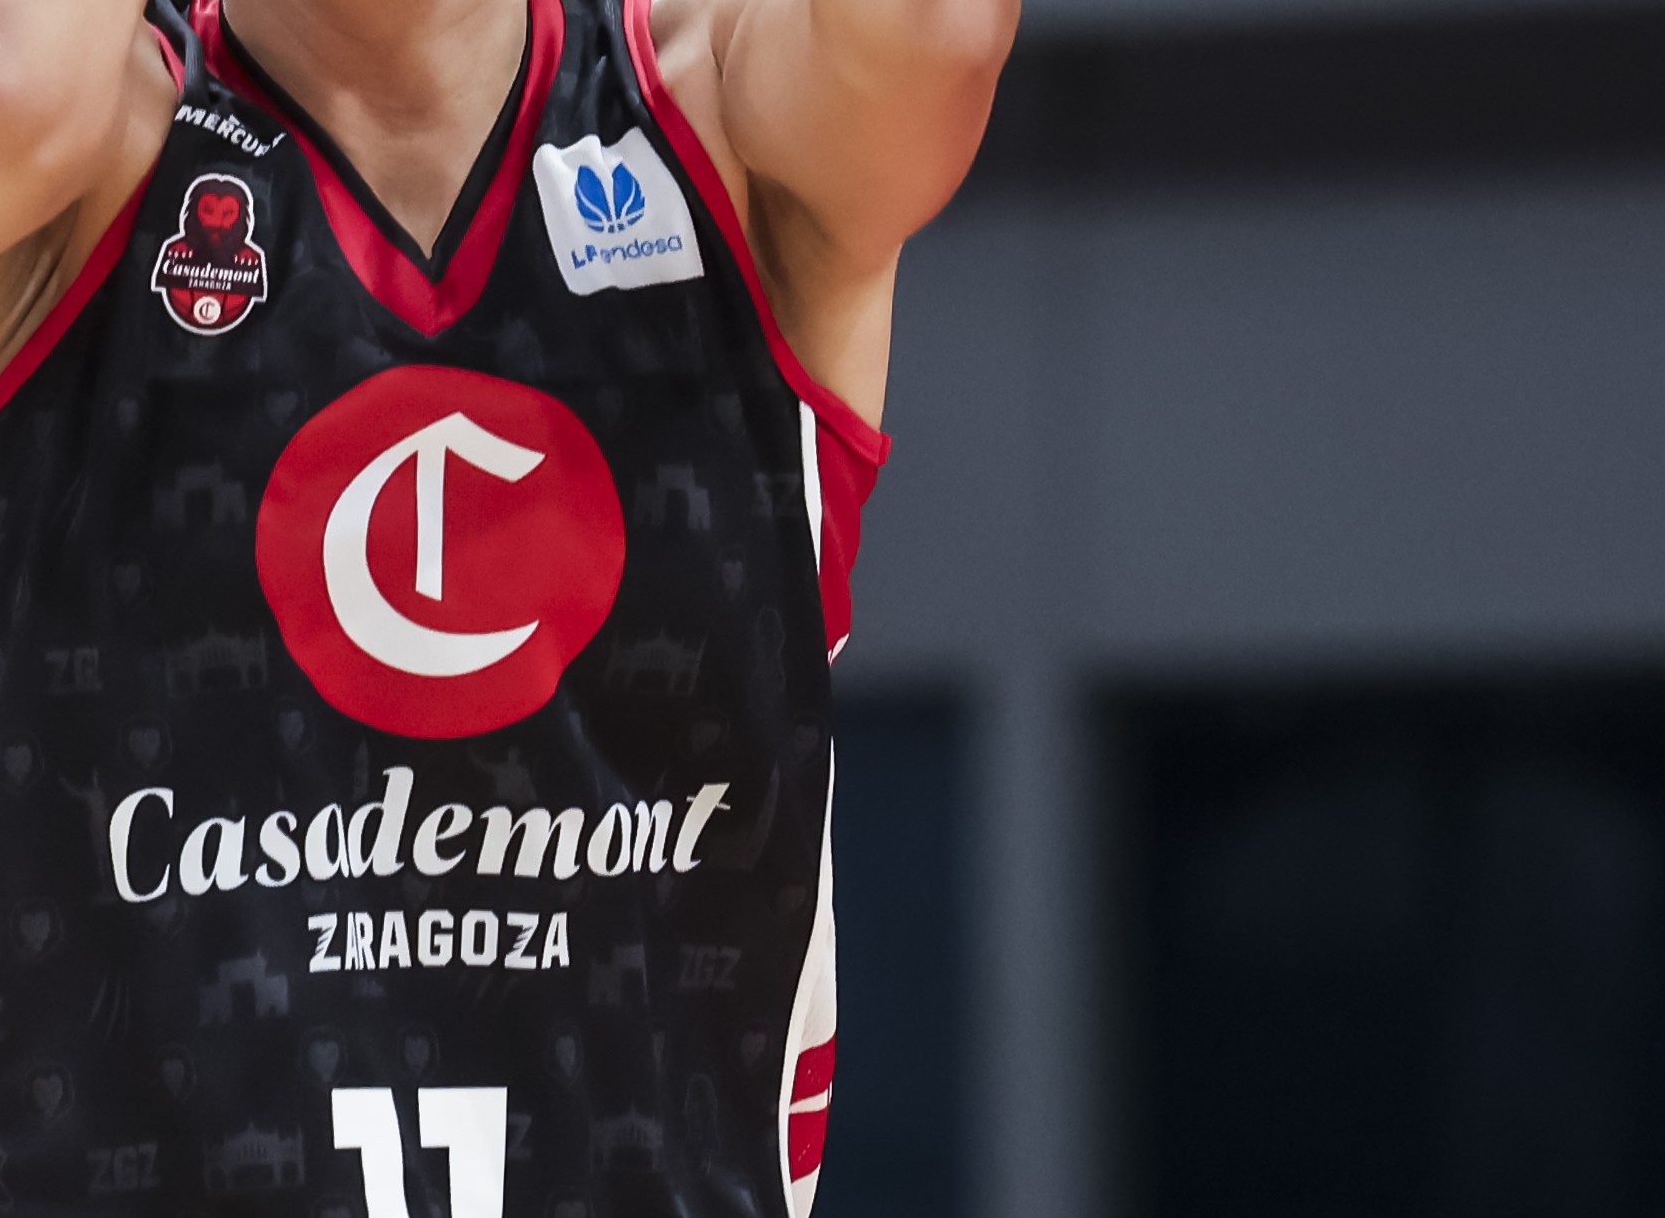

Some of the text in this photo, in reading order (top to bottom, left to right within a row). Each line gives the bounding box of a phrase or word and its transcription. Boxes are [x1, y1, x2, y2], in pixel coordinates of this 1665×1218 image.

[162, 259, 260, 284] Casademont
[323, 411, 547, 678] C
[109, 766, 731, 903] Casademont
